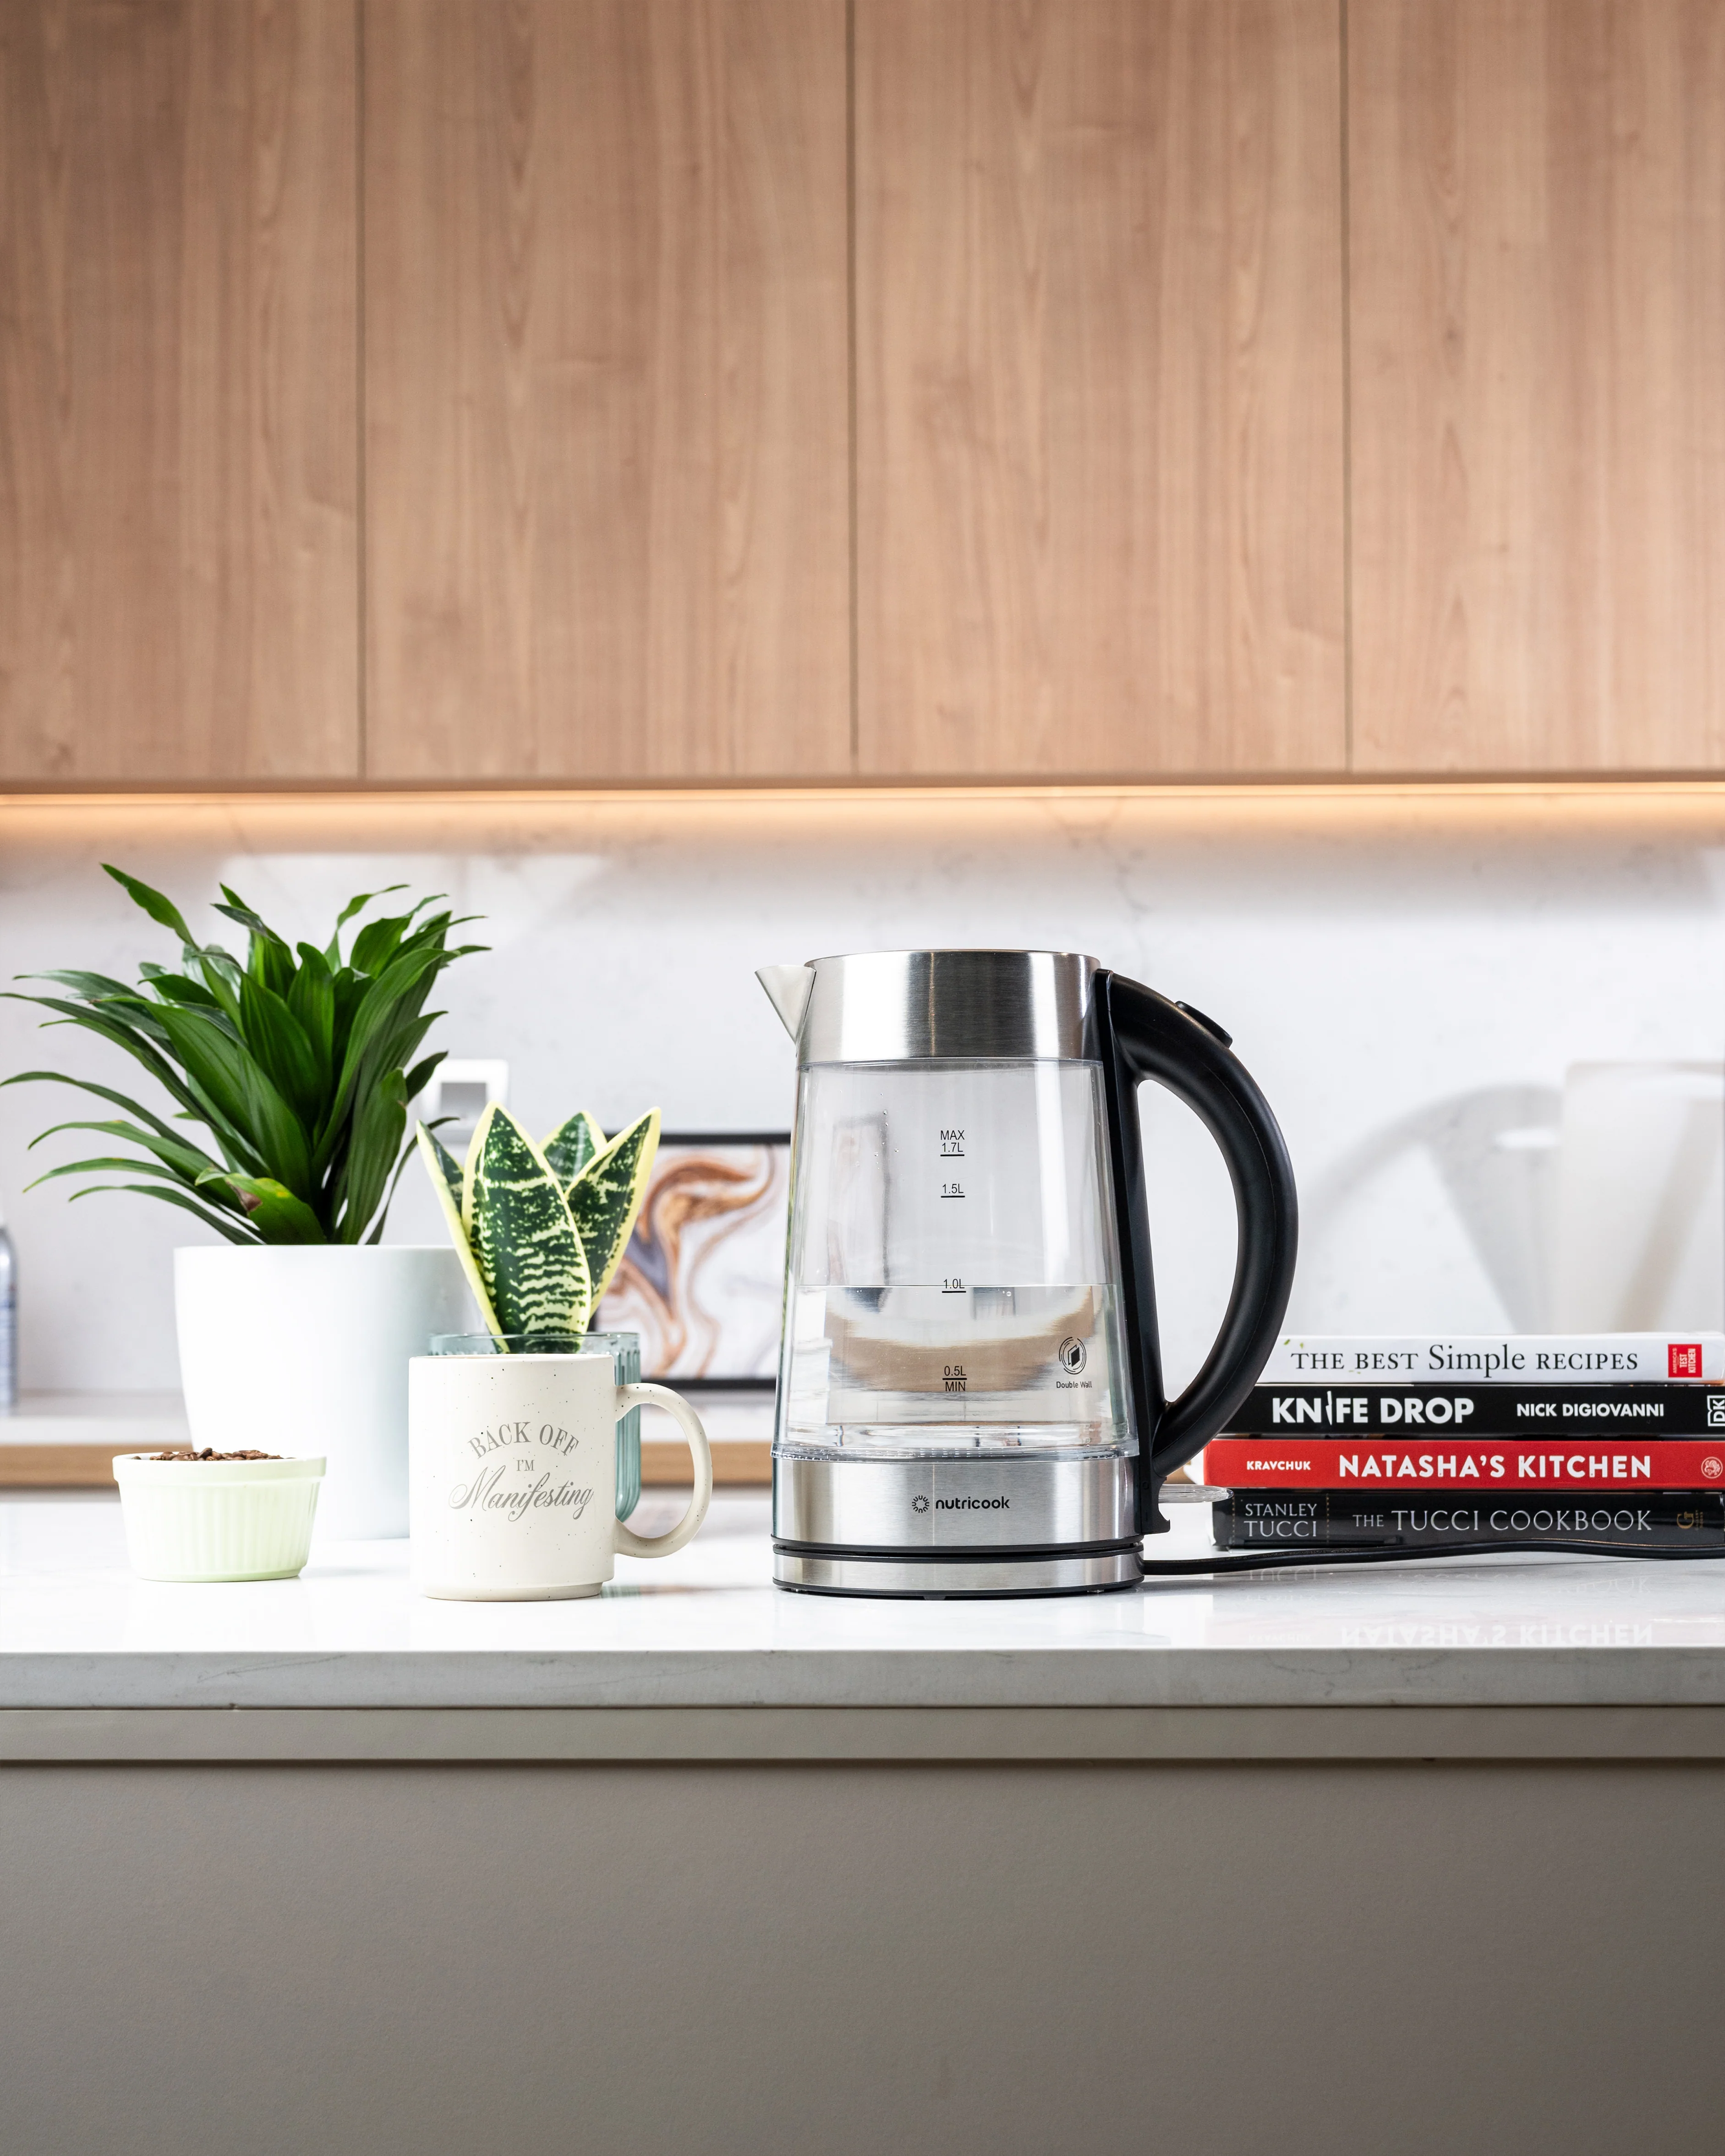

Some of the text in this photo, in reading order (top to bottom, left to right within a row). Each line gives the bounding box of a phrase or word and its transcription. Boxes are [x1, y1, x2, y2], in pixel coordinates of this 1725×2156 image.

[940, 1130, 965, 1140] MAX
[942, 1143, 964, 1153] 1.7L
[942, 1184, 964, 1193] 1.5L
[943, 1279, 965, 1289] 1.0L
[1291, 1344, 1638, 1378] THE BEST Simple RECIPES
[1679, 1353, 1687, 1368] TEST
[944, 1366, 966, 1376] 0.5L
[945, 1381, 966, 1391] MIN
[1272, 1390, 1474, 1425] KNIFE DROP
[1517, 1403, 1664, 1417] NICK DIGIOVANNI
[1713, 1399, 1725, 1422] DK
[467, 1422, 579, 1459] BACK OFF
[516, 1460, 535, 1472] I'M
[1247, 1461, 1311, 1470] KRAVCHUK
[1339, 1455, 1650, 1478] NATASHA'S KITCHEN
[449, 1465, 594, 1521] Manifesting
[936, 1496, 1010, 1509] nutricook
[1245, 1504, 1317, 1516] STANLEY
[1353, 1510, 1652, 1531] THE TUCCI COOKBOOK
[1243, 1521, 1317, 1537] TUCCI
